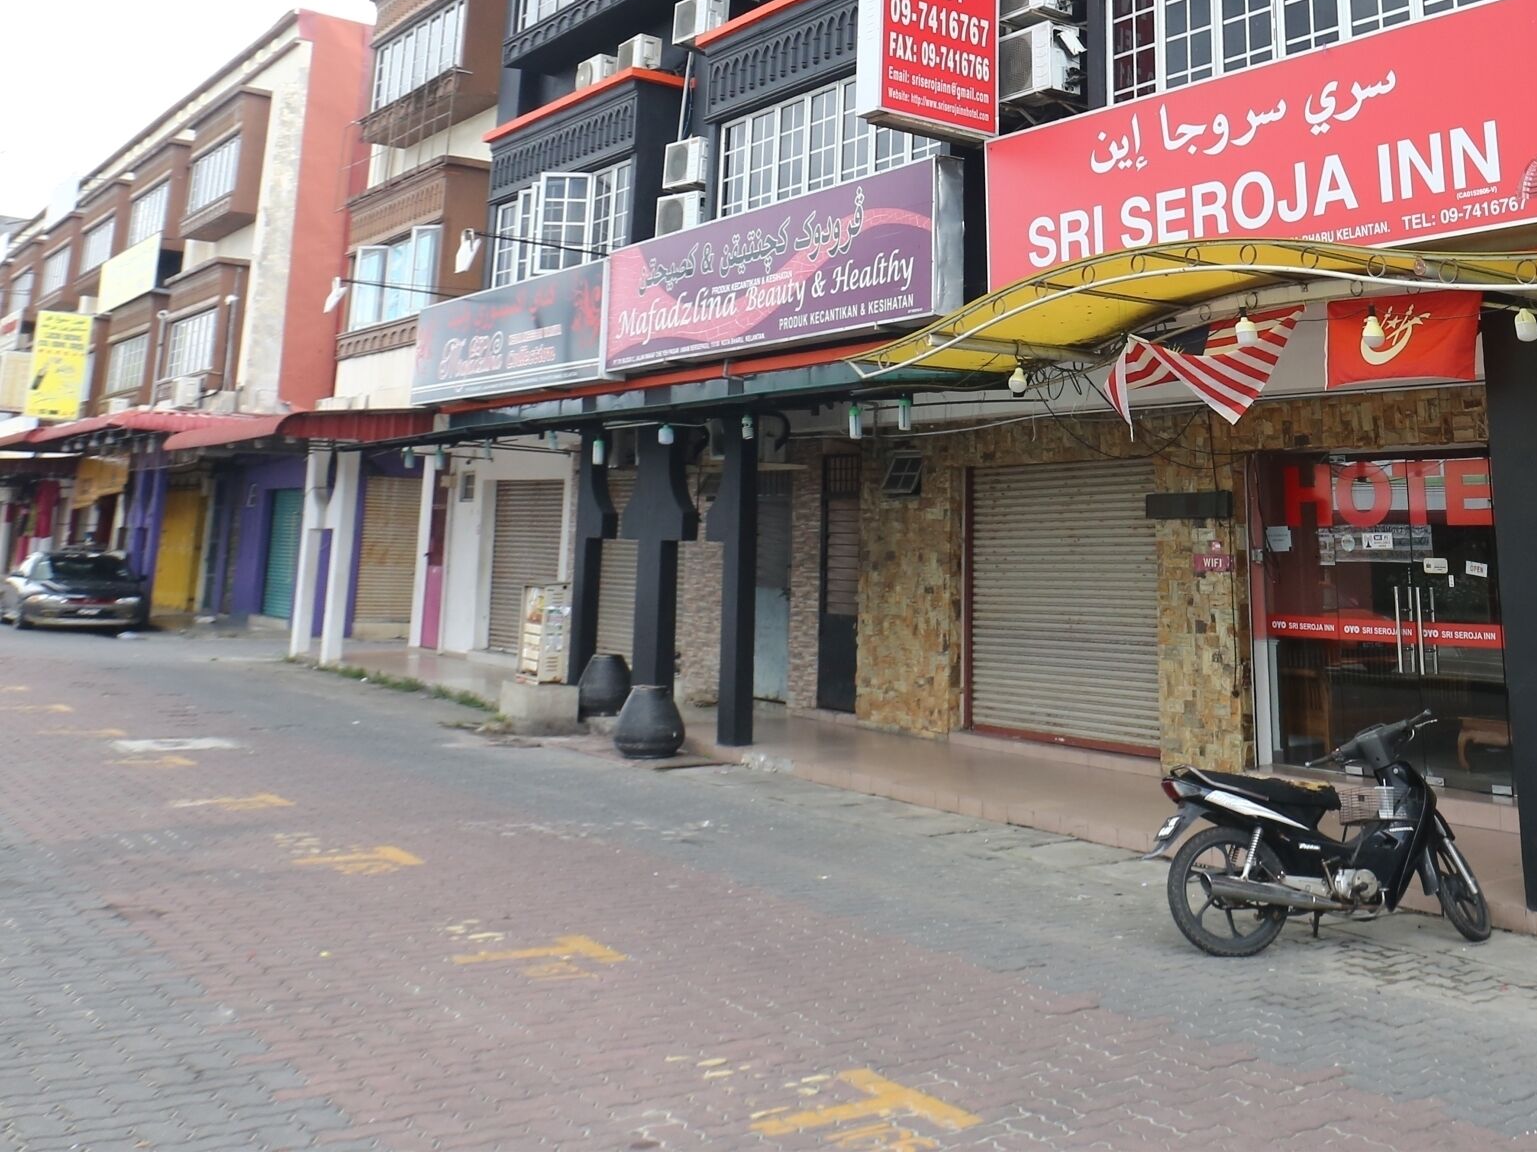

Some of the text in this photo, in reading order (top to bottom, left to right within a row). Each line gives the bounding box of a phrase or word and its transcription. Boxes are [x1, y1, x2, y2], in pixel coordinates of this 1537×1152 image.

[889, 31, 990, 82] FAX: 09-7416766
[888, 65, 910, 84] Email:
[1089, 69, 1397, 174] سري سروجا إين
[1028, 120, 1501, 268] SRI SEROJA INN
[1336, 221, 1391, 241] KELANTAN.
[1401, 212, 1437, 231] TEL:
[615, 249, 915, 345] Mafadzlina Beauty & Healthy
[778, 293, 914, 332] PRODUK KECANTIKAN & KESIHATAN
[1283, 459, 1494, 527] HOTE
[1203, 558, 1222, 567] WIFI
[1469, 564, 1484, 574] OPEN
[1272, 620, 1286, 629] OYO
[1299, 623, 1324, 631] SEROJA
[1324, 624, 1335, 632] INN
[1344, 625, 1360, 634] OYO
[1362, 626, 1373, 634] SRI
[1441, 630, 1453, 638] SRI
[1454, 631, 1483, 640] SEROJA
[1484, 632, 1496, 640] INN
